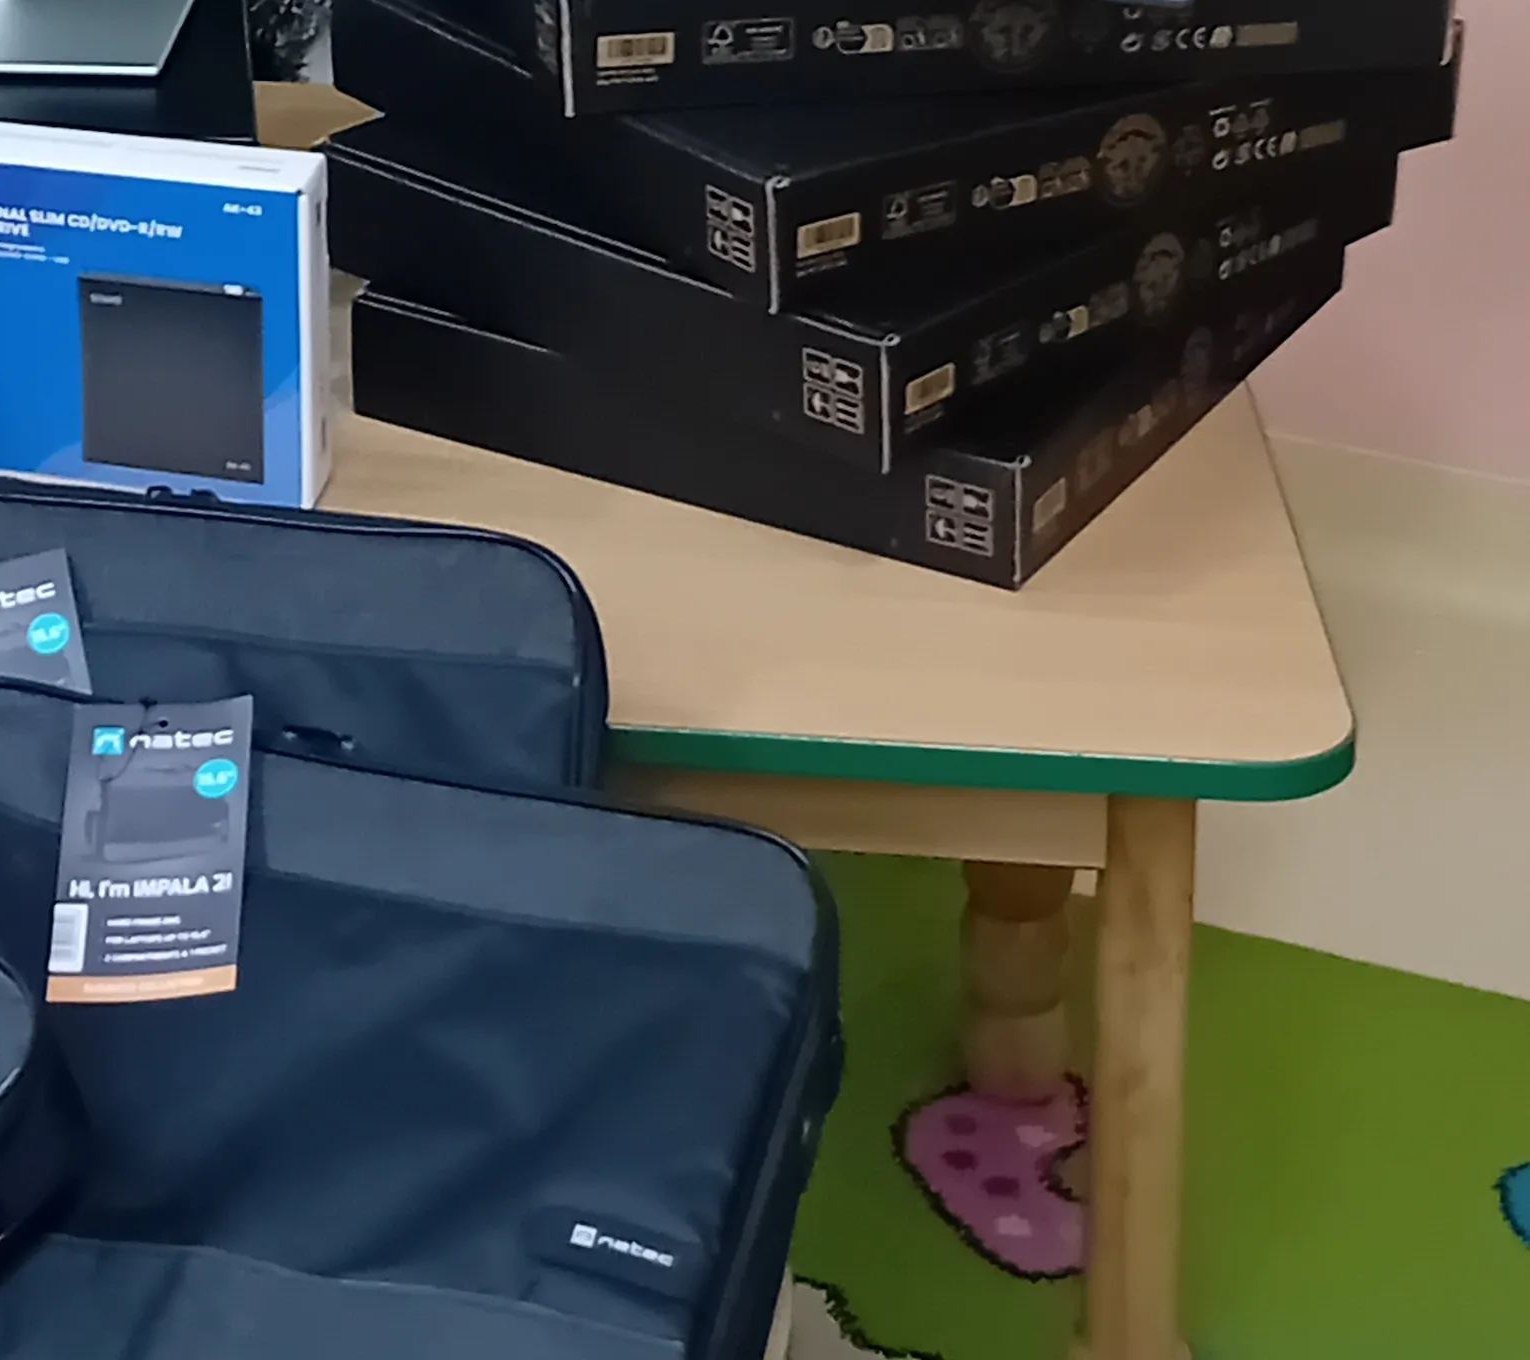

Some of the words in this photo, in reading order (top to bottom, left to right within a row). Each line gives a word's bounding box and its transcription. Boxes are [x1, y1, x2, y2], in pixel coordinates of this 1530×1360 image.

[28, 208, 65, 226] SLIM
[129, 728, 235, 750] natec
[98, 880, 130, 899] I'm
[133, 875, 210, 898] IMPALA
[211, 872, 233, 892] 2!
[597, 1235, 675, 1268] natec
